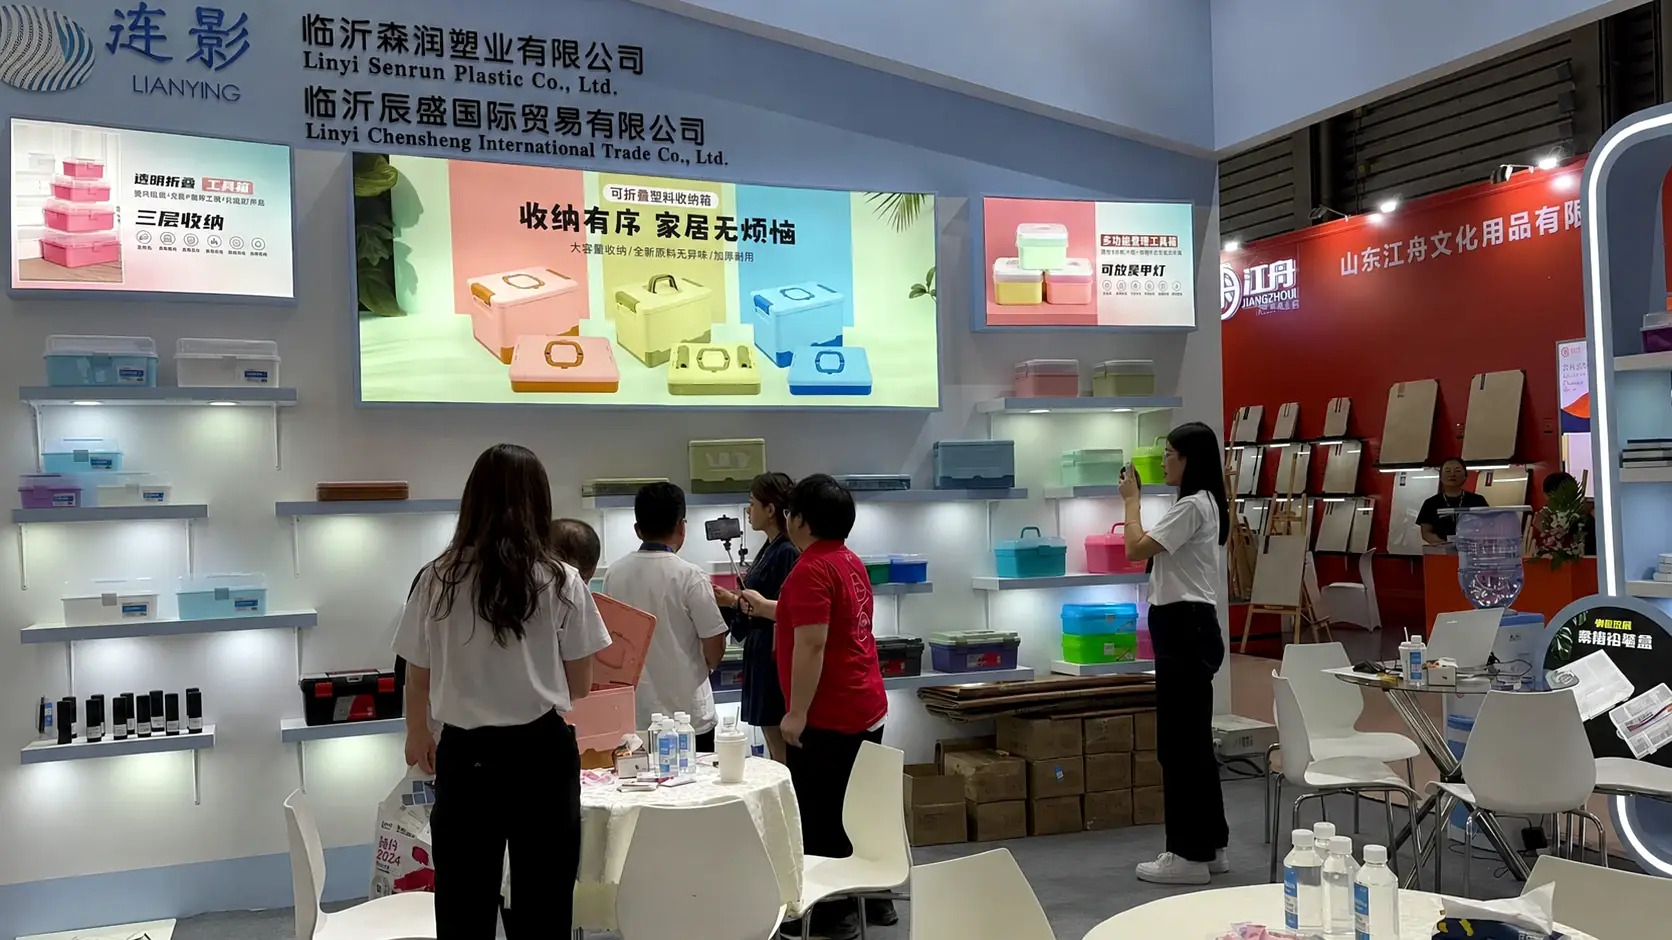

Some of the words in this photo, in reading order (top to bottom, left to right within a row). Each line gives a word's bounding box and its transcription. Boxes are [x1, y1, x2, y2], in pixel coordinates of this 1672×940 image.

[105, 1, 250, 71] 连影
[302, 13, 644, 76] 临沂森润塑业有限公司
[132, 75, 241, 102] LIANYING
[304, 51, 359, 76] Linyi
[369, 57, 445, 80] Senrun
[454, 64, 524, 87] Plastic
[532, 72, 570, 94] Co.,
[579, 76, 618, 96] Ltd.
[304, 85, 705, 146] 临沂辰盛国际贸易有限公司
[306, 122, 359, 145] Linyi
[368, 127, 472, 152] Chensheng
[479, 134, 595, 158] International
[602, 143, 651, 161] Trade
[658, 147, 690, 167] Co.,
[697, 150, 729, 166] Ltd.
[610, 186, 712, 207] 可折叠塑料收纳箱
[135, 209, 224, 231] 三层收纳
[519, 201, 641, 237] 收纳有序
[655, 211, 797, 245] 家居无烦恼
[1340, 199, 1582, 277] 山东江舟文化用品有限
[1242, 258, 1297, 296] 江舟
[376, 849, 401, 866] 2024
